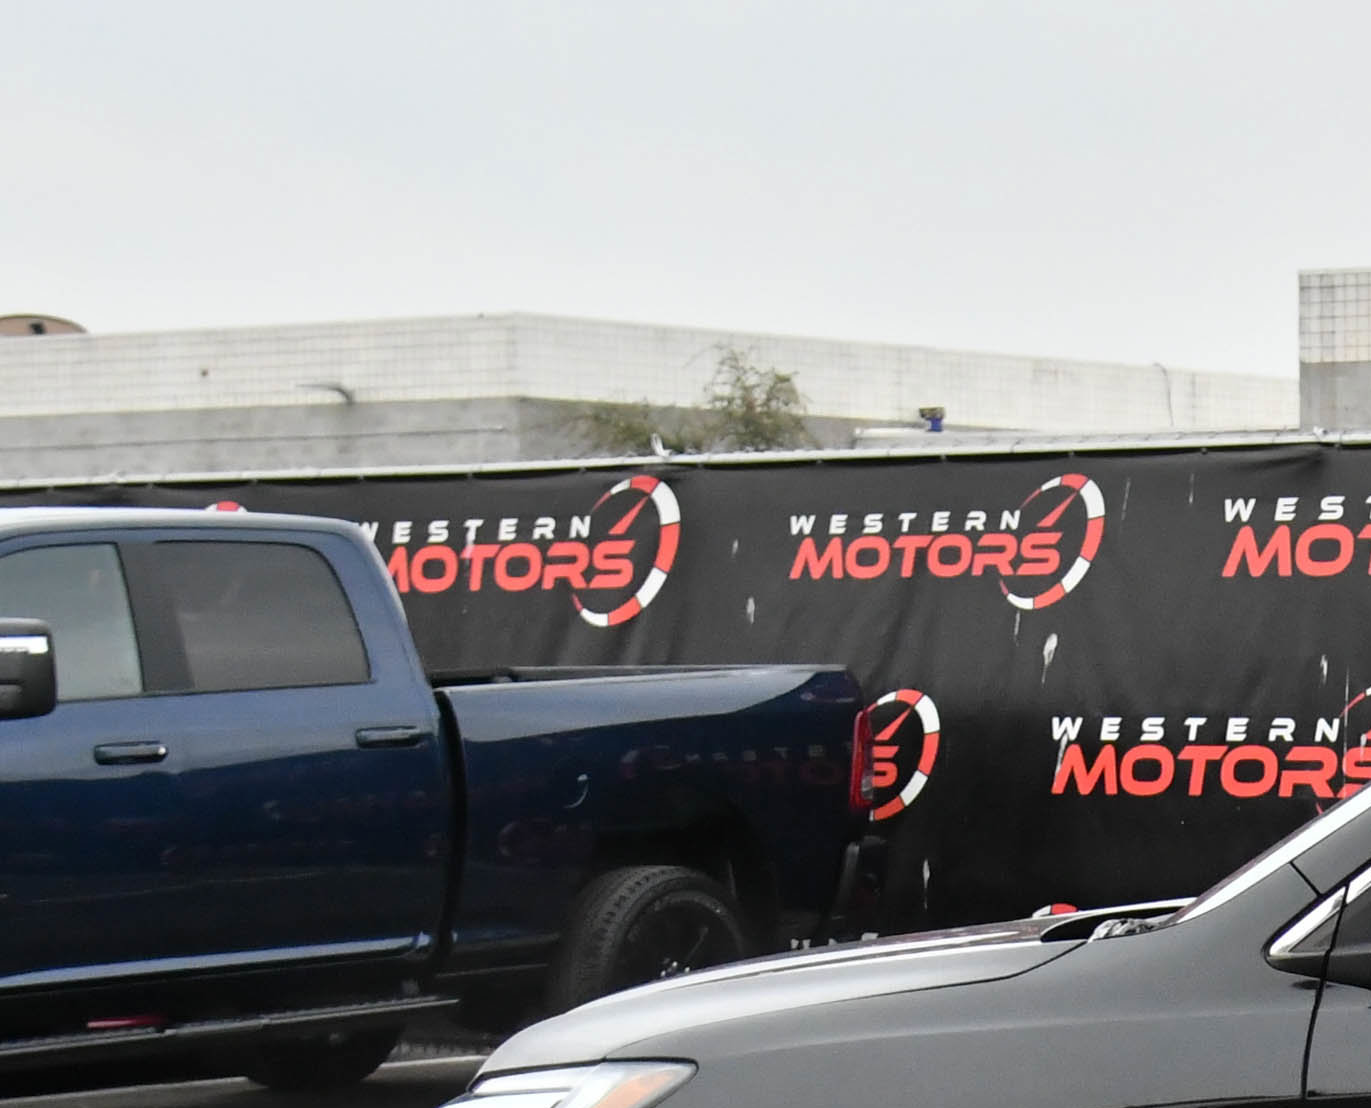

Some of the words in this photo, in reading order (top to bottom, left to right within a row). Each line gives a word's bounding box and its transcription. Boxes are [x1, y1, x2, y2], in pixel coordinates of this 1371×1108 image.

[790, 509, 1021, 536] WESTERN
[789, 532, 1063, 580] MOTORS
[1051, 716, 1340, 743] WESTERN
